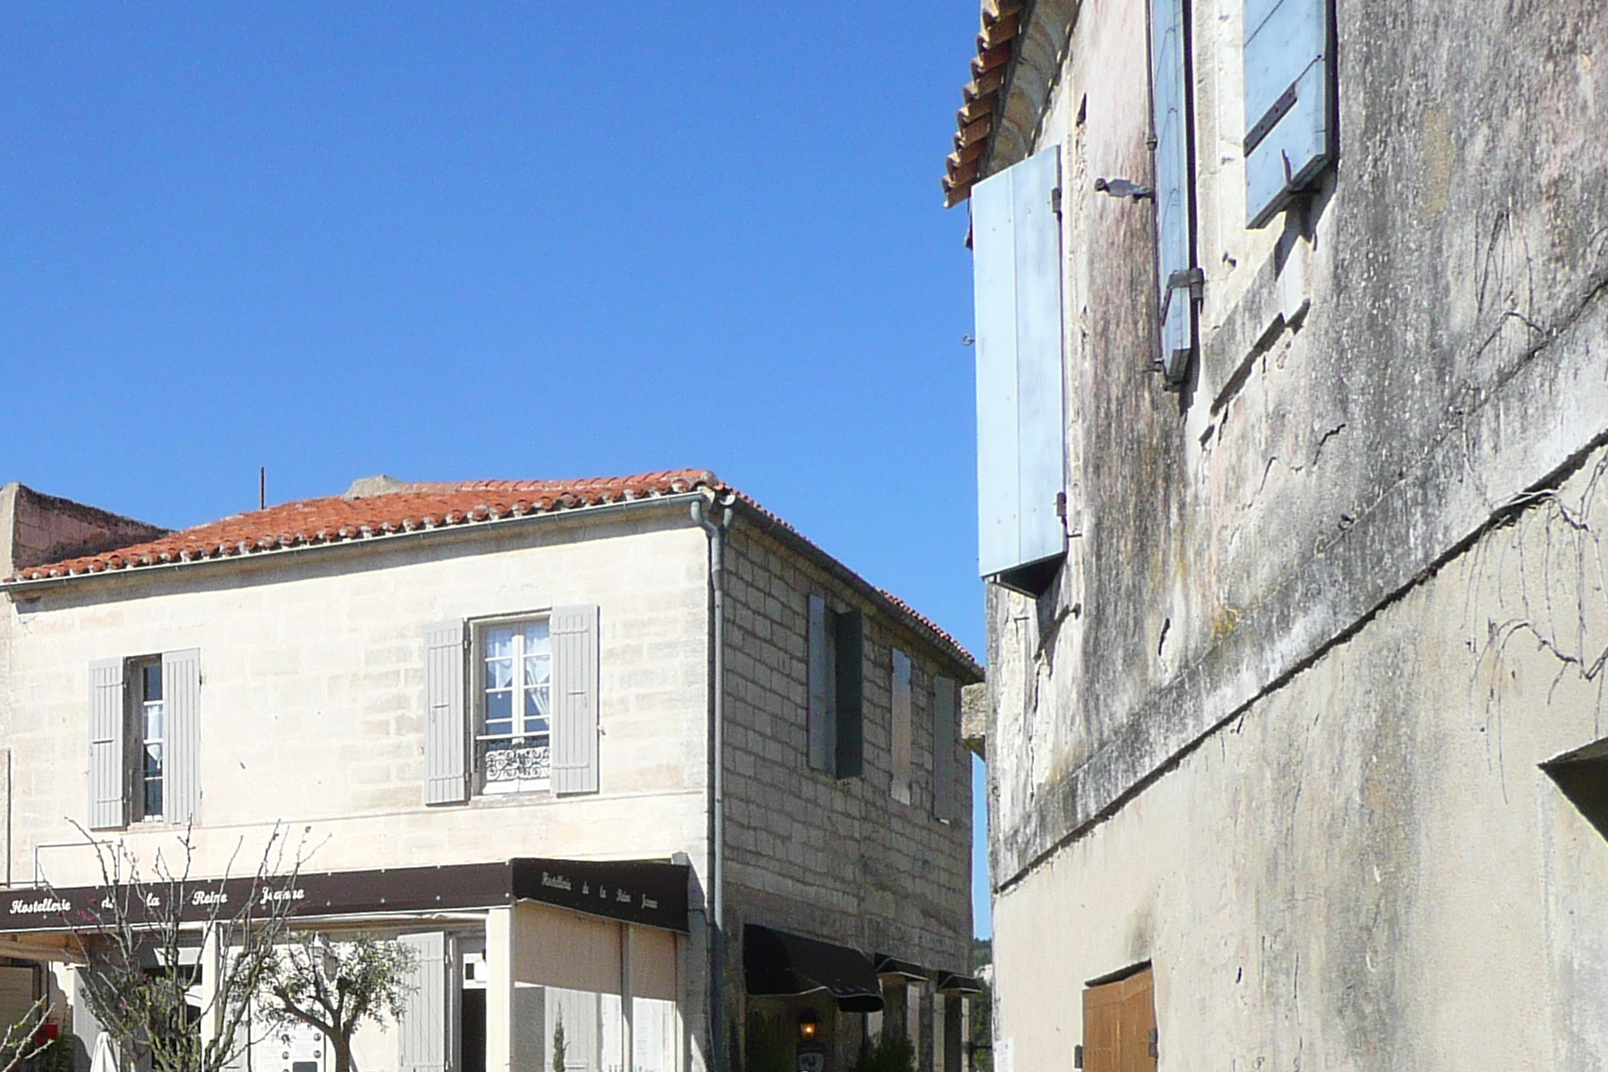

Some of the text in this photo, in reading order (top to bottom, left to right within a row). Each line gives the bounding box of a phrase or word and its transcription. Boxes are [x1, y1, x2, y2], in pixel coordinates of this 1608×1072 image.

[9, 897, 72, 915] Hostellerie
[146, 892, 161, 907] la
[192, 890, 228, 906] Reine
